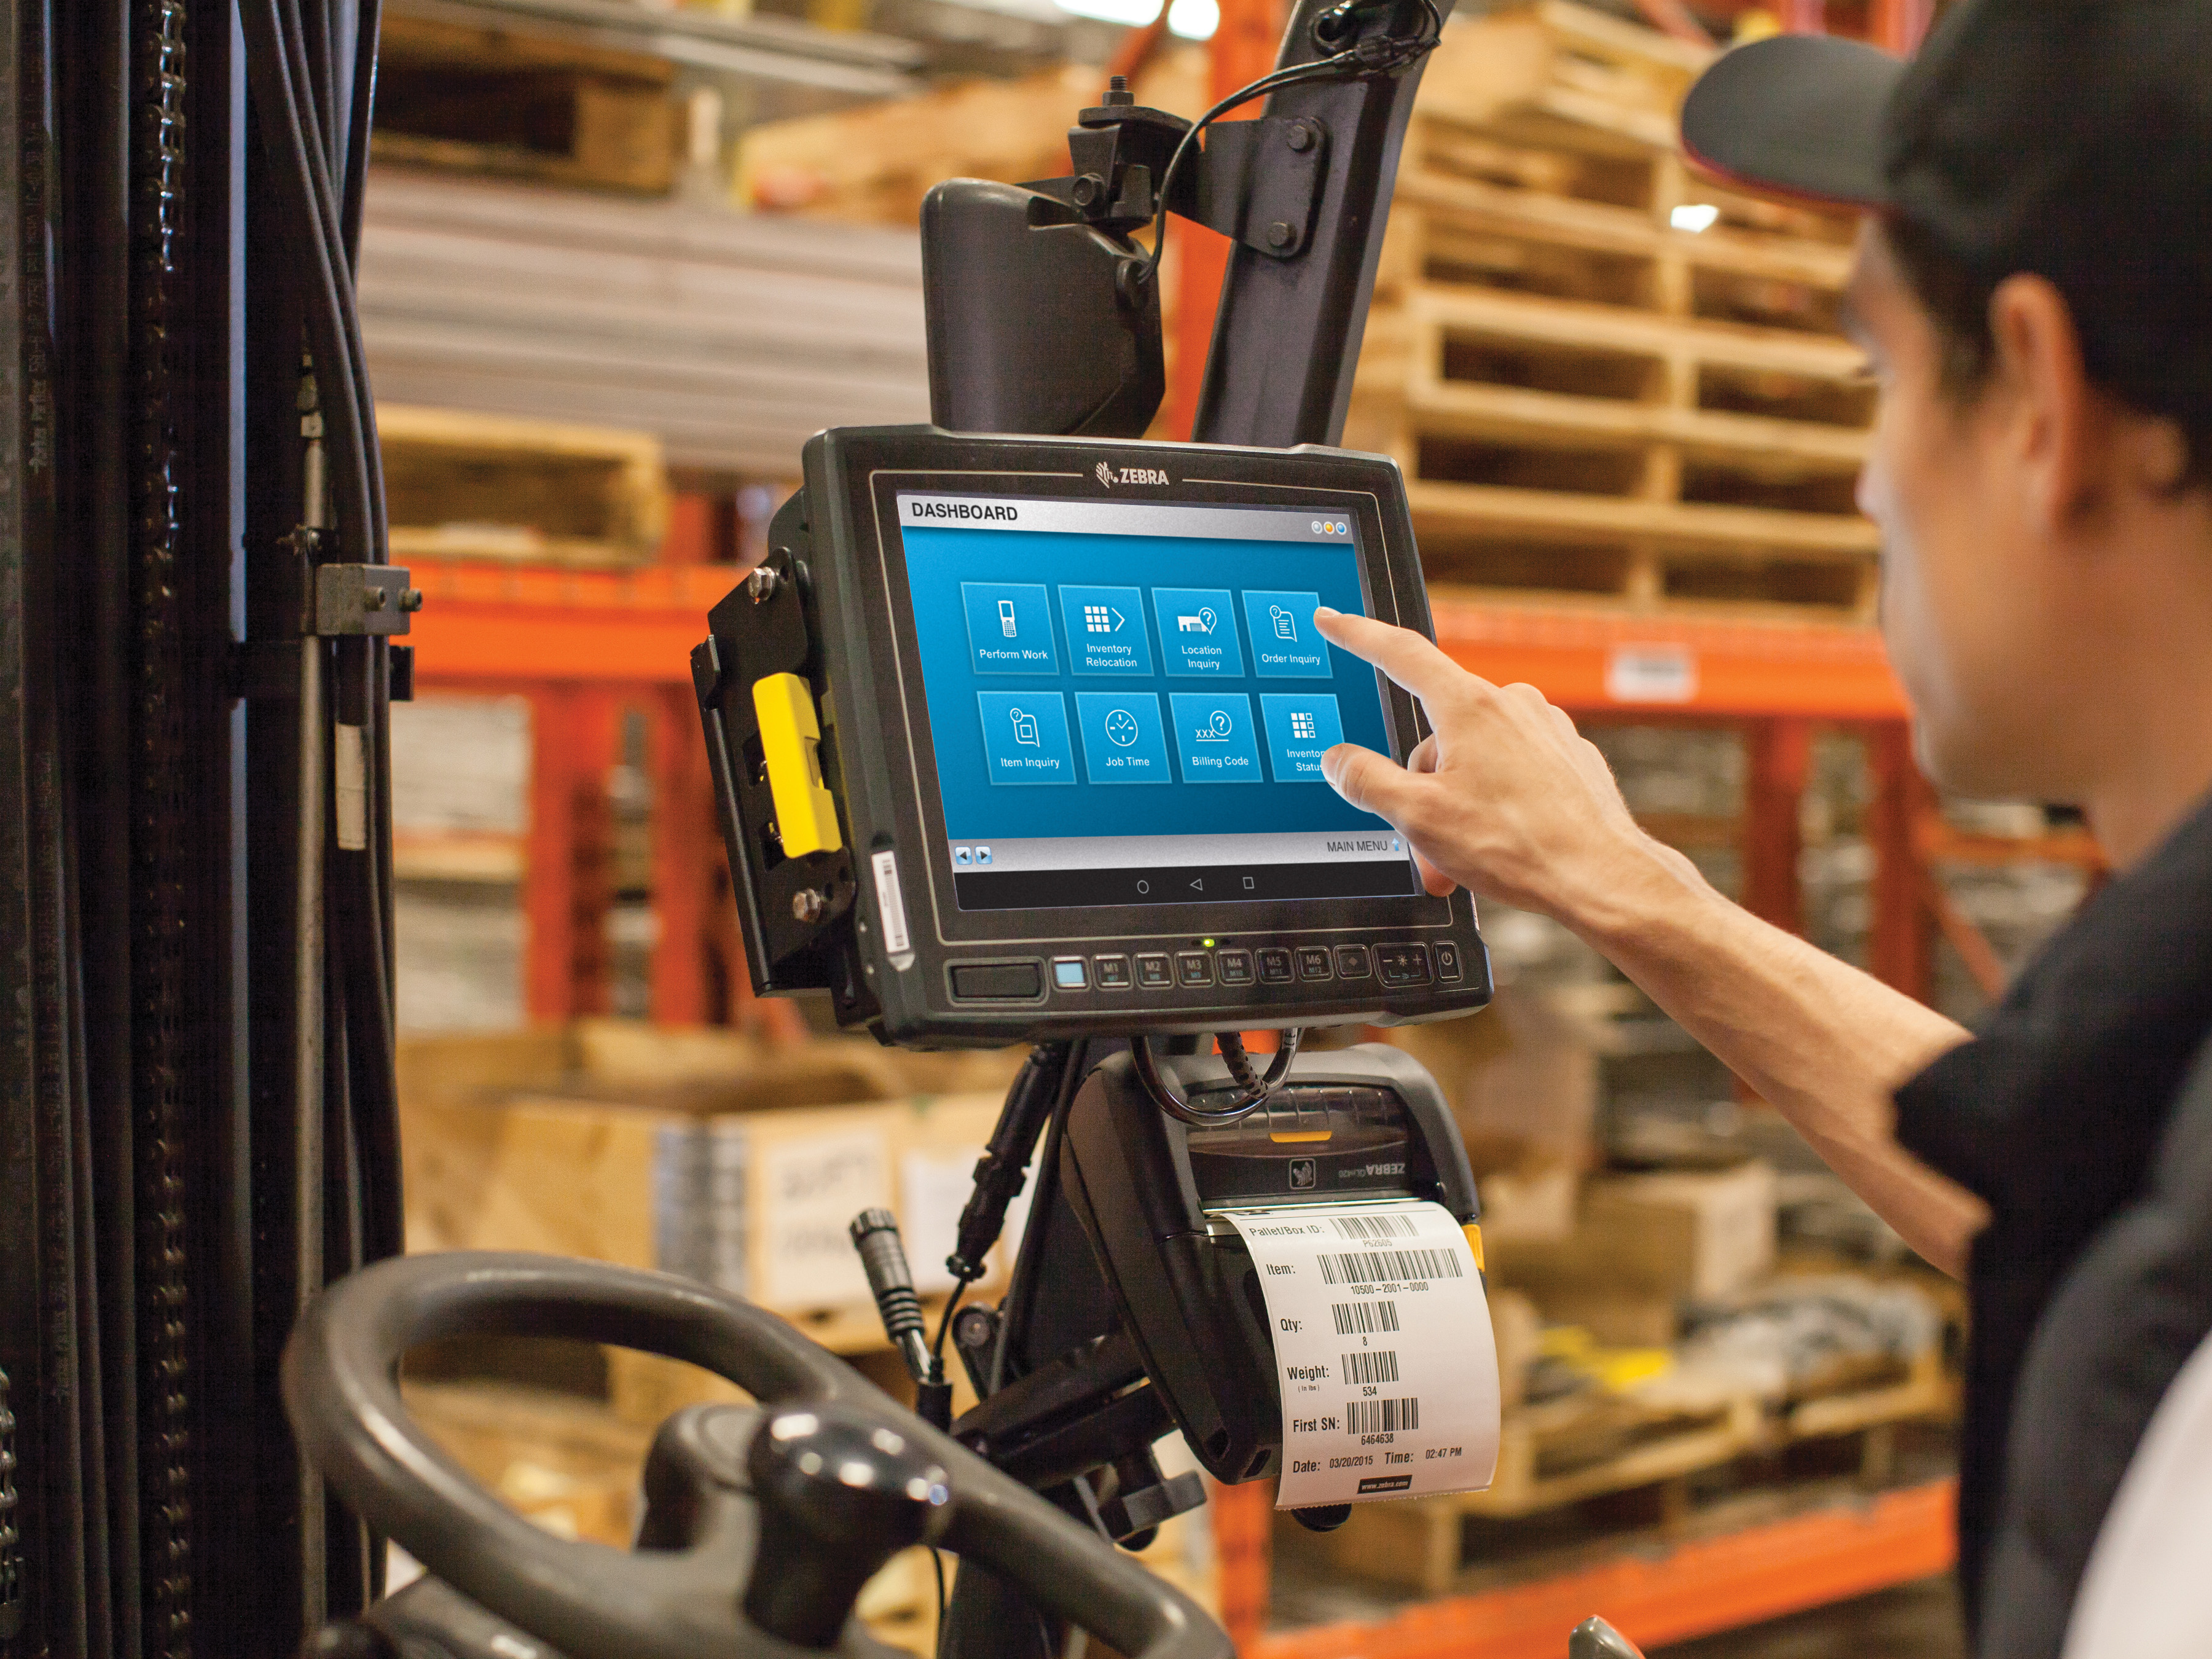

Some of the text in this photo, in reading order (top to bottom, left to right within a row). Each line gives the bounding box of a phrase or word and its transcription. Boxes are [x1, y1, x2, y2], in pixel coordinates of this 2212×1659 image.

[1120, 468, 1169, 485] ZEBRA
[912, 502, 1018, 521] DASHBOARD
[979, 649, 1048, 659] Perform Work
[1086, 643, 1132, 655] Inventory
[1182, 645, 1222, 655] Location
[1086, 657, 1137, 667] Relocation
[1188, 659, 1220, 670] Inquiry
[1261, 654, 1320, 665] Order Inquiry
[1287, 749, 1325, 758] Inventor
[1001, 758, 1060, 769] Item Inquiry
[1106, 757, 1150, 766] Job Time
[1192, 756, 1249, 767] Billing Code
[1296, 762, 1322, 771] Statu
[1327, 840, 1388, 852] MAIN MENU
[1186, 960, 1202, 970] M3
[1227, 958, 1242, 968] M4
[1266, 957, 1282, 967] M5
[1306, 955, 1322, 965] M6
[1104, 963, 1118, 973] M1
[1145, 962, 1161, 971] M2
[1365, 1163, 1405, 1176] ZEBRA
[1249, 1225, 1325, 1236] Pallet/Box ID:
[1362, 1238, 1393, 1248] P62605
[1266, 1263, 1296, 1276] Item:
[1280, 1319, 1303, 1333] Qty:
[1362, 1336, 1368, 1346] 8
[1287, 1365, 1330, 1381] Weight:
[1362, 1386, 1377, 1397] 534
[1293, 1417, 1340, 1432] First SN:
[1361, 1433, 1394, 1445] 6464638
[1293, 1446, 1462, 1473] Date: 03/20/2015 Time: 02:47 PM
